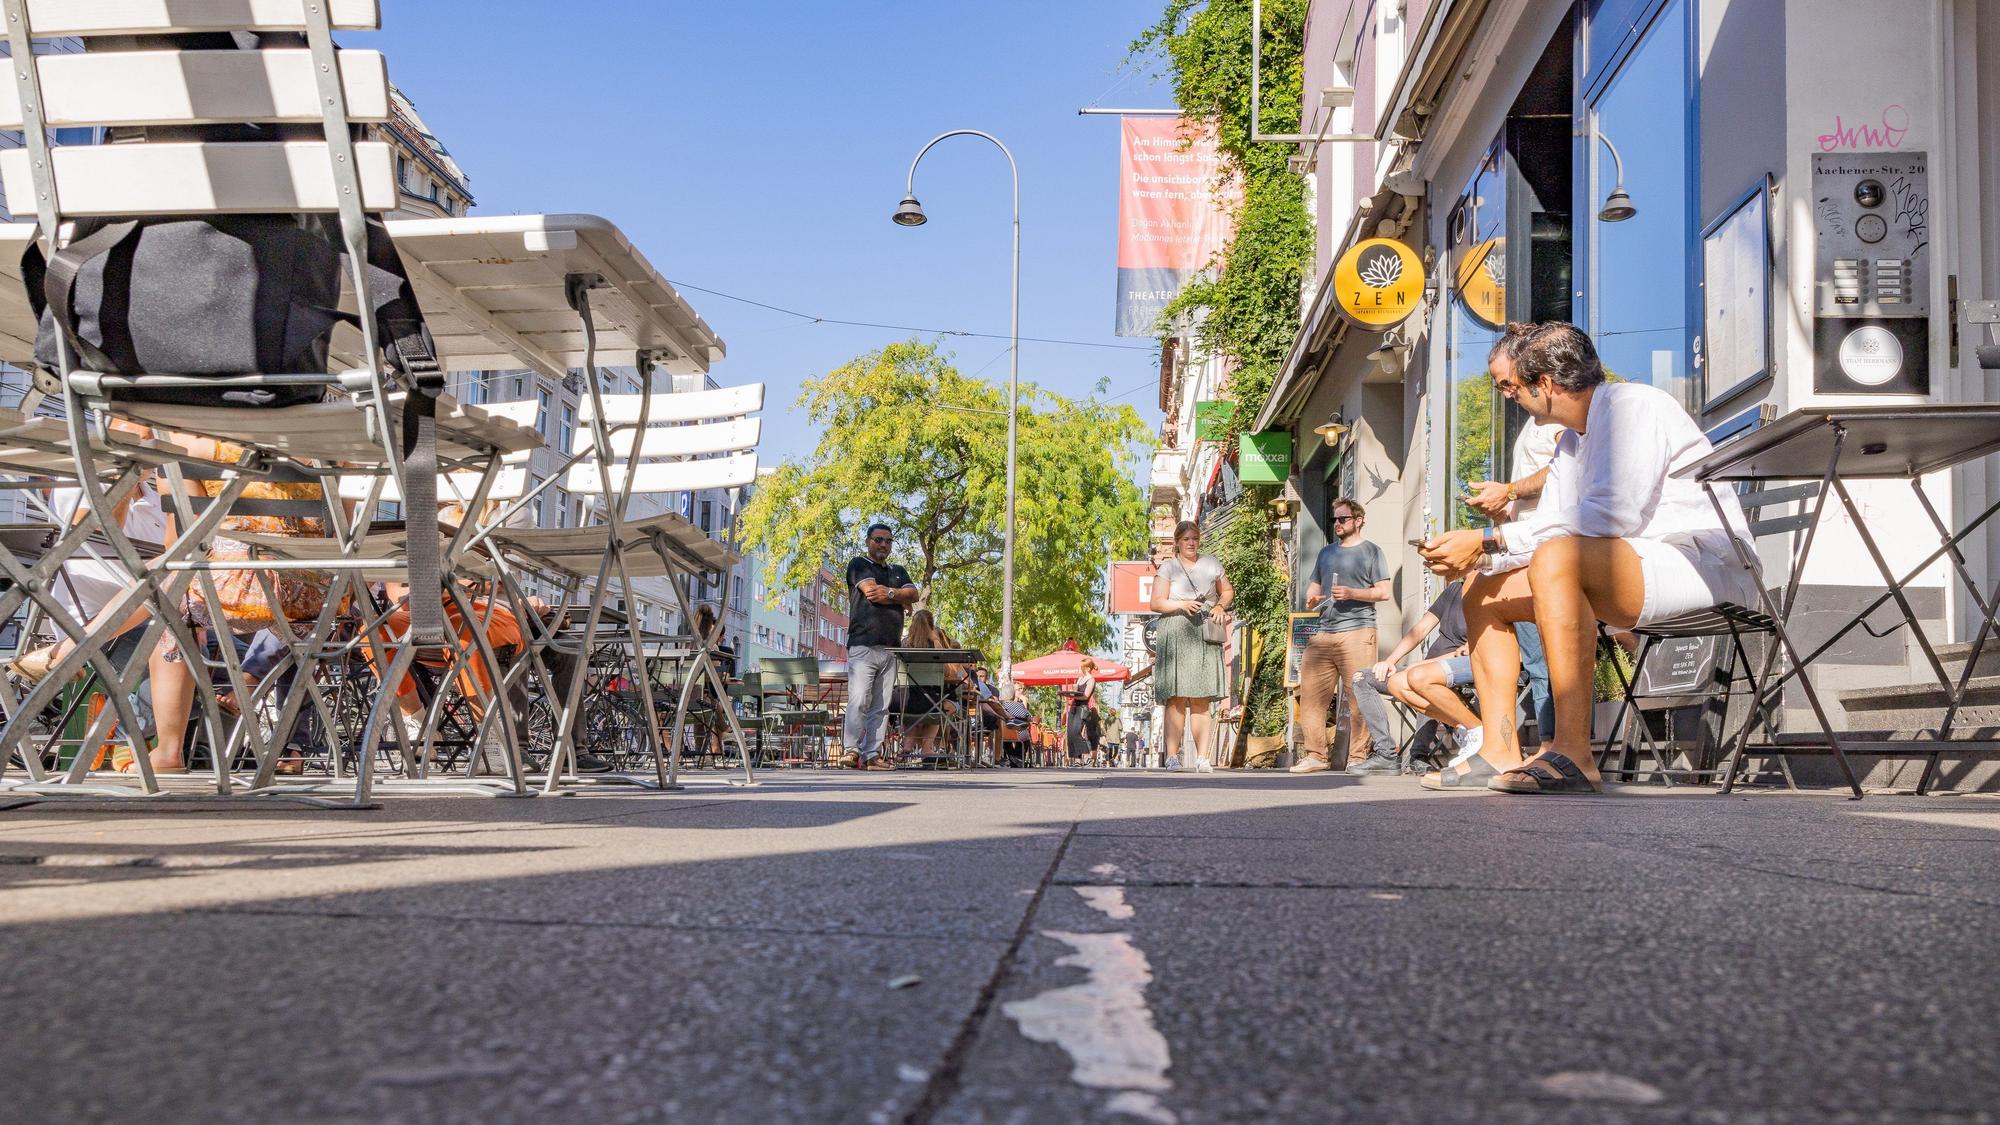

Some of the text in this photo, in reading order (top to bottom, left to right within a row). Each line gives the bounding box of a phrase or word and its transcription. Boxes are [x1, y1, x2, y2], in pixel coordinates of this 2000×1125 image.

[1133, 136, 1149, 146] Am
[1153, 136, 1190, 148] Himme
[1133, 151, 1161, 162] schon
[1164, 151, 1193, 165] längst
[1908, 166, 1925, 175] 20
[1133, 172, 1149, 183] Die
[1132, 189, 1162, 199] waren
[1164, 189, 1187, 201] fern,
[1128, 290, 1173, 301] THEATER
[1354, 291, 1405, 306] ZEN
[1245, 453, 1285, 463] moxxa
[1132, 693, 1149, 704] EIS
